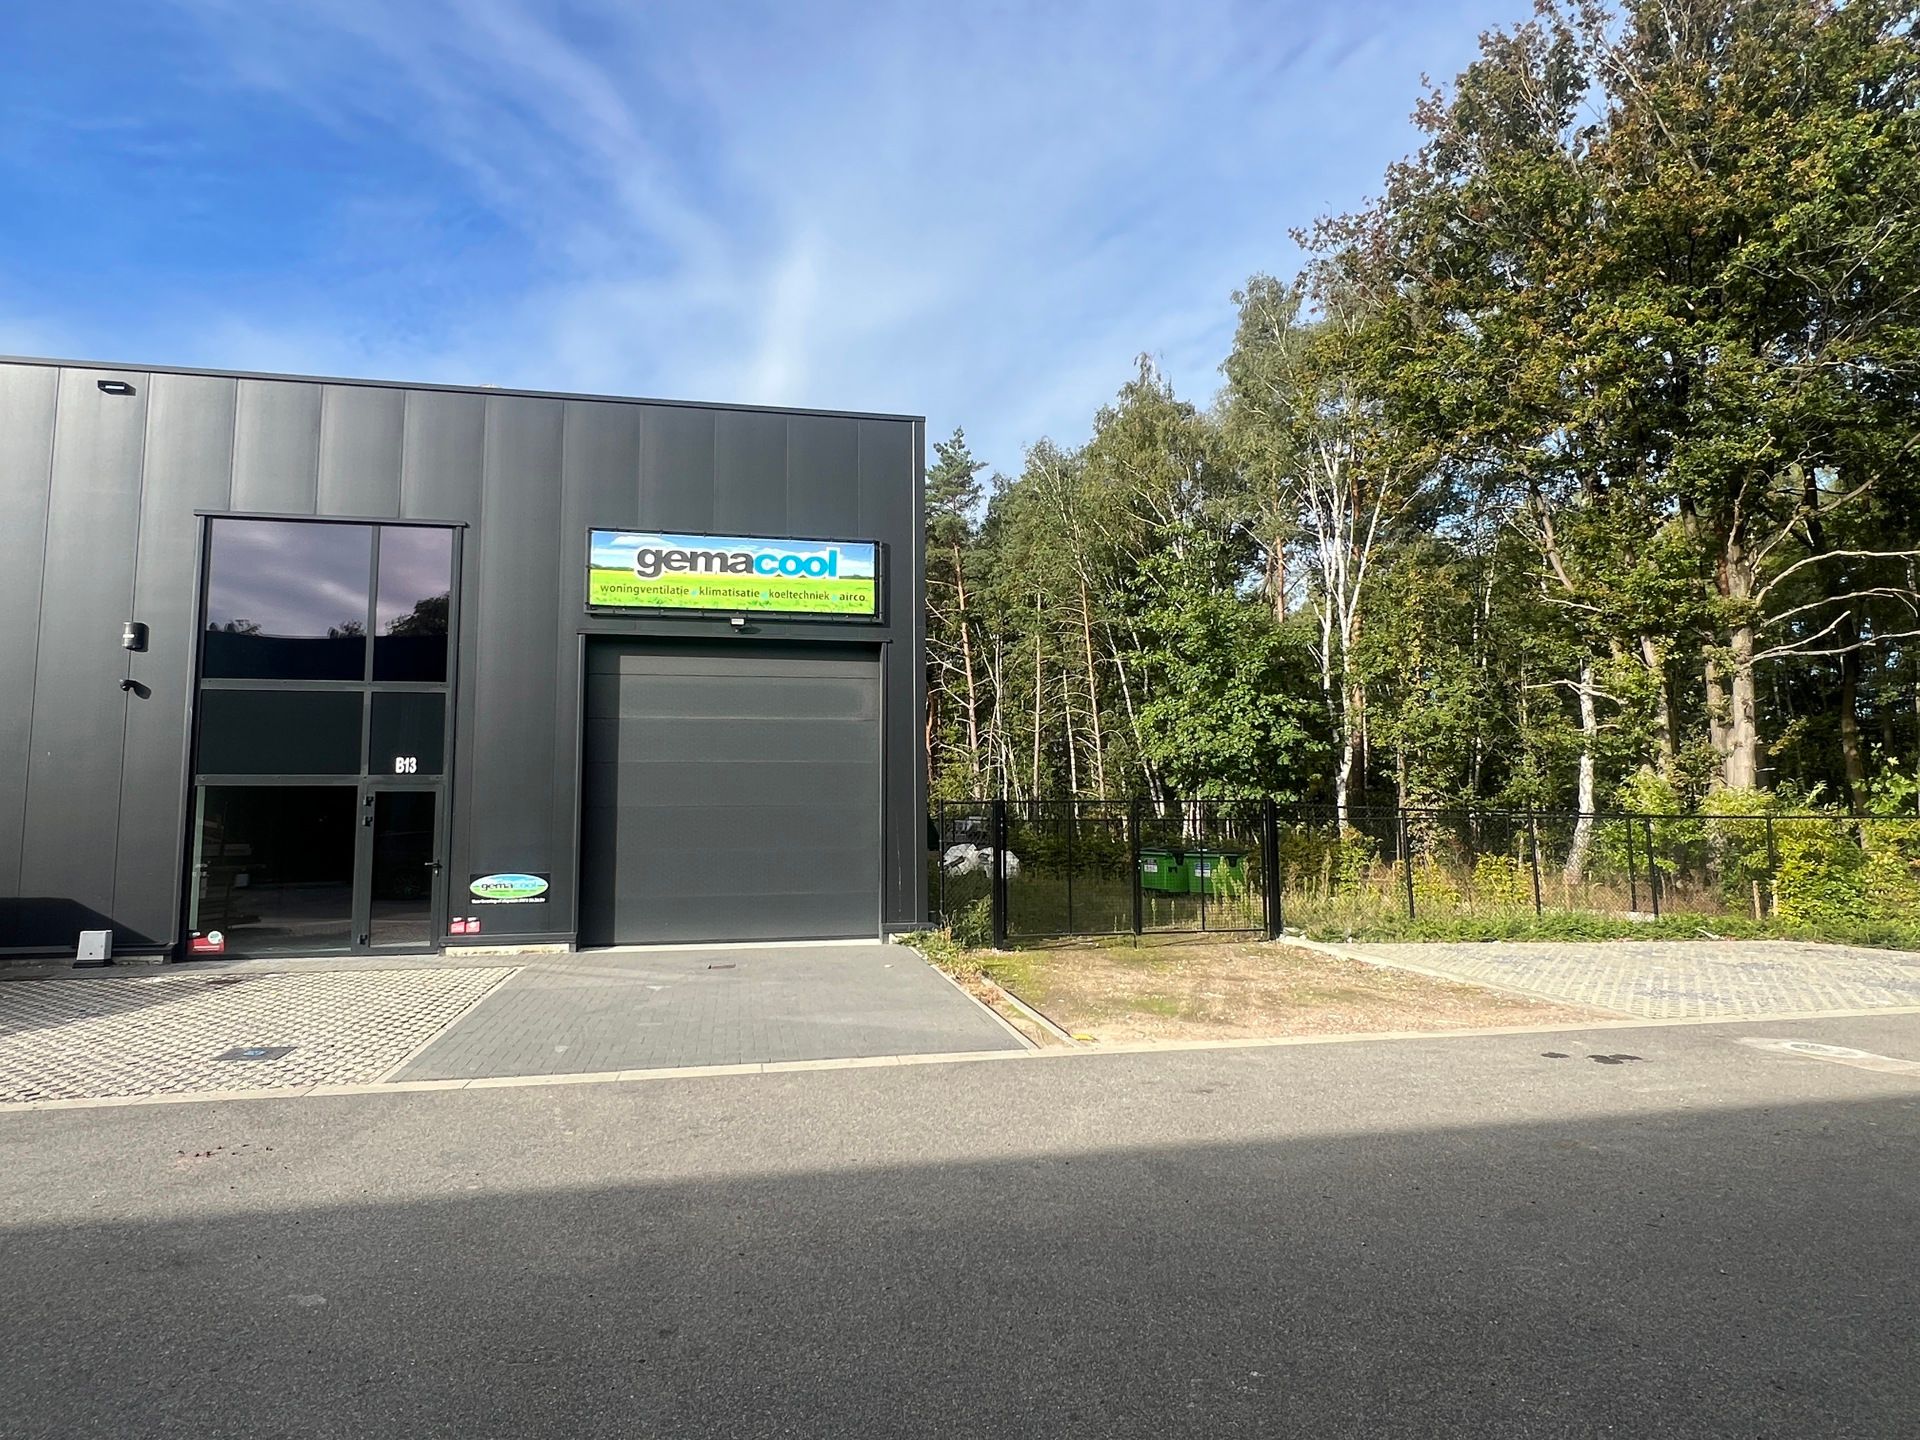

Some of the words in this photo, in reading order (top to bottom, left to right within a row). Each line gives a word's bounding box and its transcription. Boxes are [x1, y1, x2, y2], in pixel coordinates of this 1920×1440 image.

[637, 549, 838, 578] gemacool
[600, 584, 690, 596] woningventilatie
[699, 587, 760, 598] klimatisatie
[769, 588, 830, 601] koeltechniek
[839, 594, 866, 602] airco
[395, 756, 417, 774] B13
